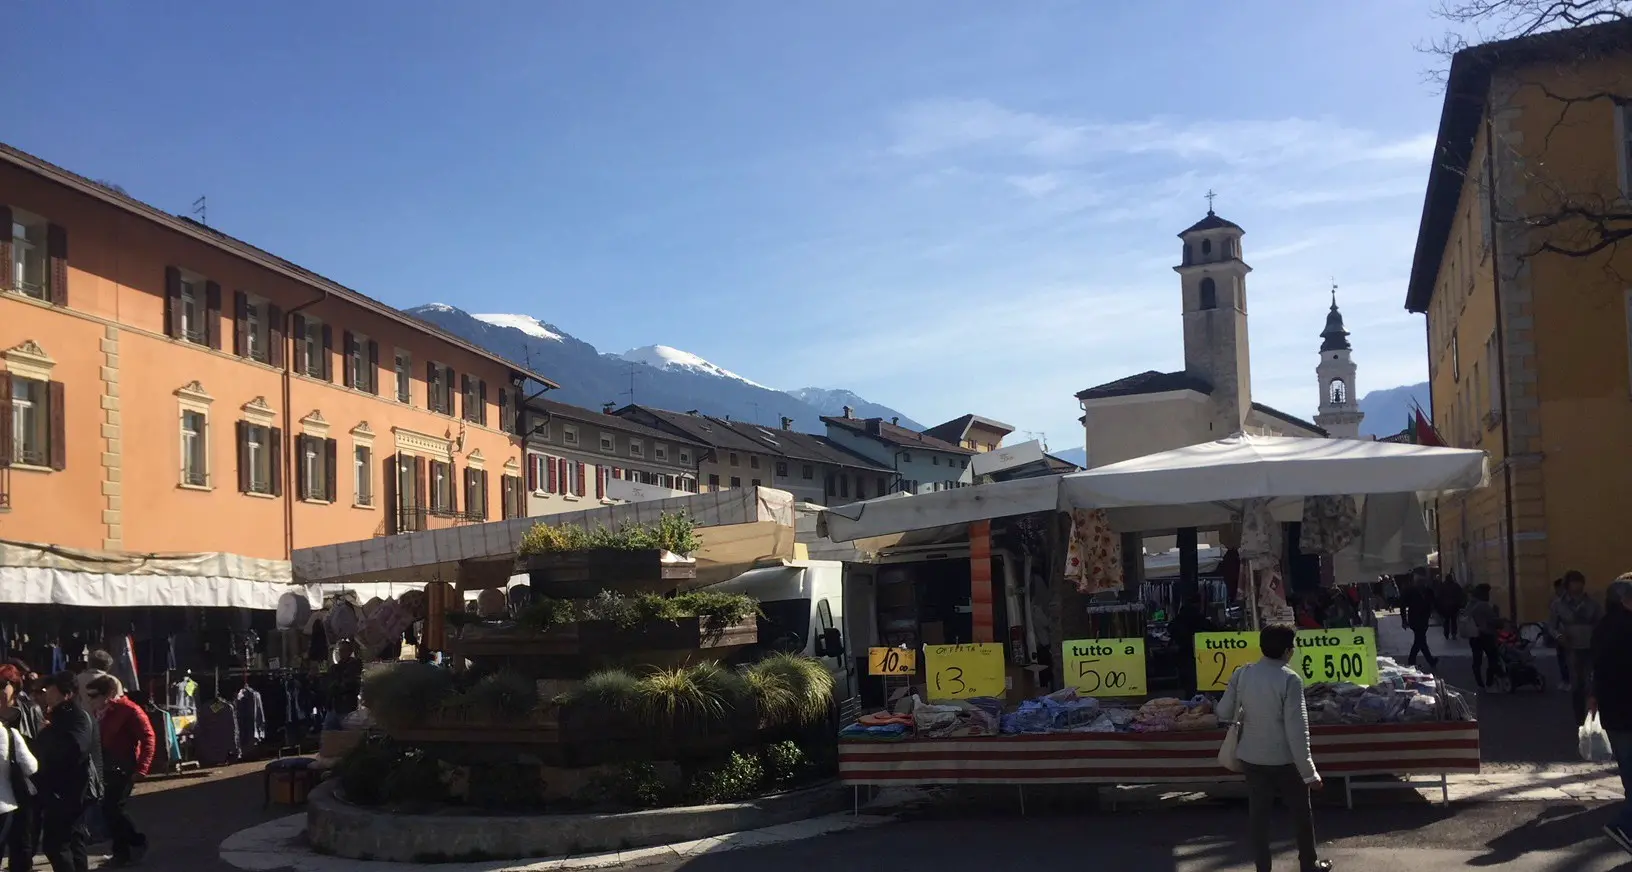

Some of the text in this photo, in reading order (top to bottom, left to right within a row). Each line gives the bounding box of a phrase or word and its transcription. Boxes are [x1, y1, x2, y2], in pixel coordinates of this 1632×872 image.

[1205, 638, 1248, 649] tutto
[1295, 635, 1365, 648] tutto a
[1071, 645, 1135, 656] tutto a
[1302, 652, 1363, 682] € 5,00
